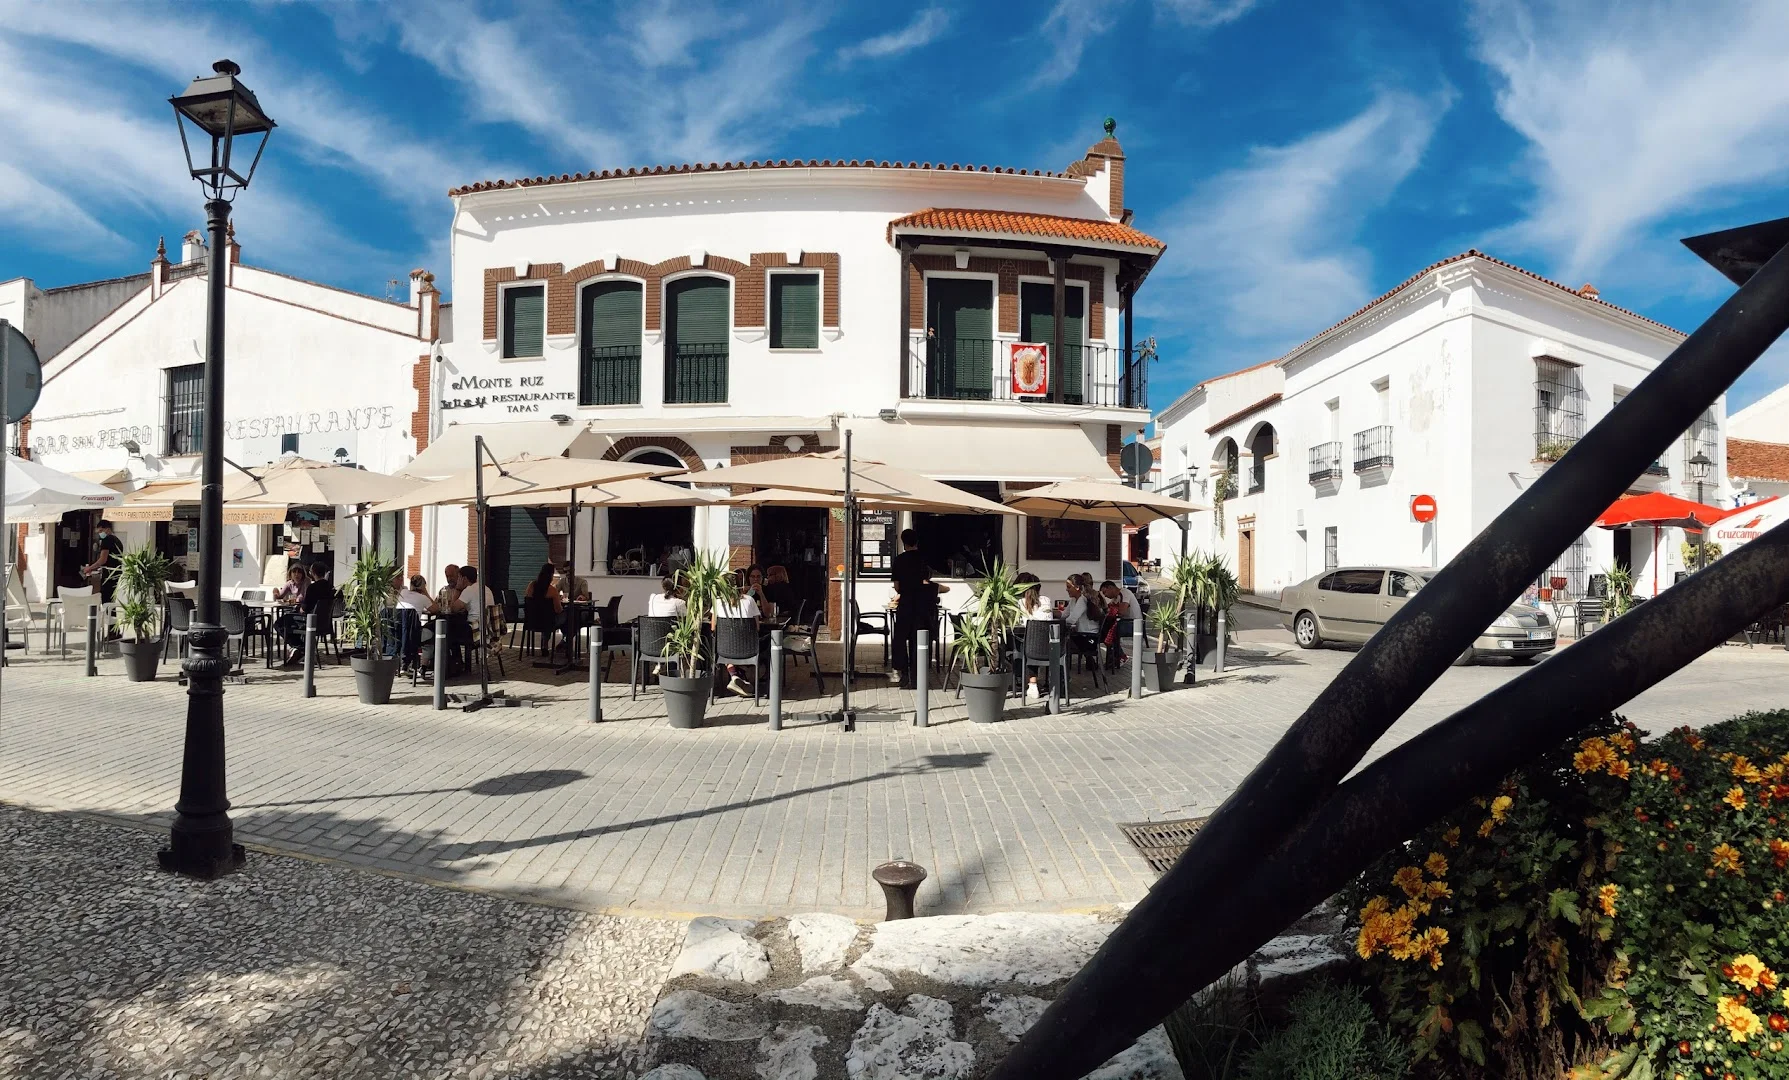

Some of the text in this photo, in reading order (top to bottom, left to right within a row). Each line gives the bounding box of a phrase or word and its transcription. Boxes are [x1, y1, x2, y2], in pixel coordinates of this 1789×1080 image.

[459, 375, 544, 390] MONTE RUZ
[492, 392, 576, 403] RESTAURANTE
[507, 404, 539, 413] TAPAS
[224, 405, 394, 440] RESTAURANTE
[35, 425, 152, 456] BAR SAN PEDRO
[1717, 529, 1763, 541] Cruzcampo
